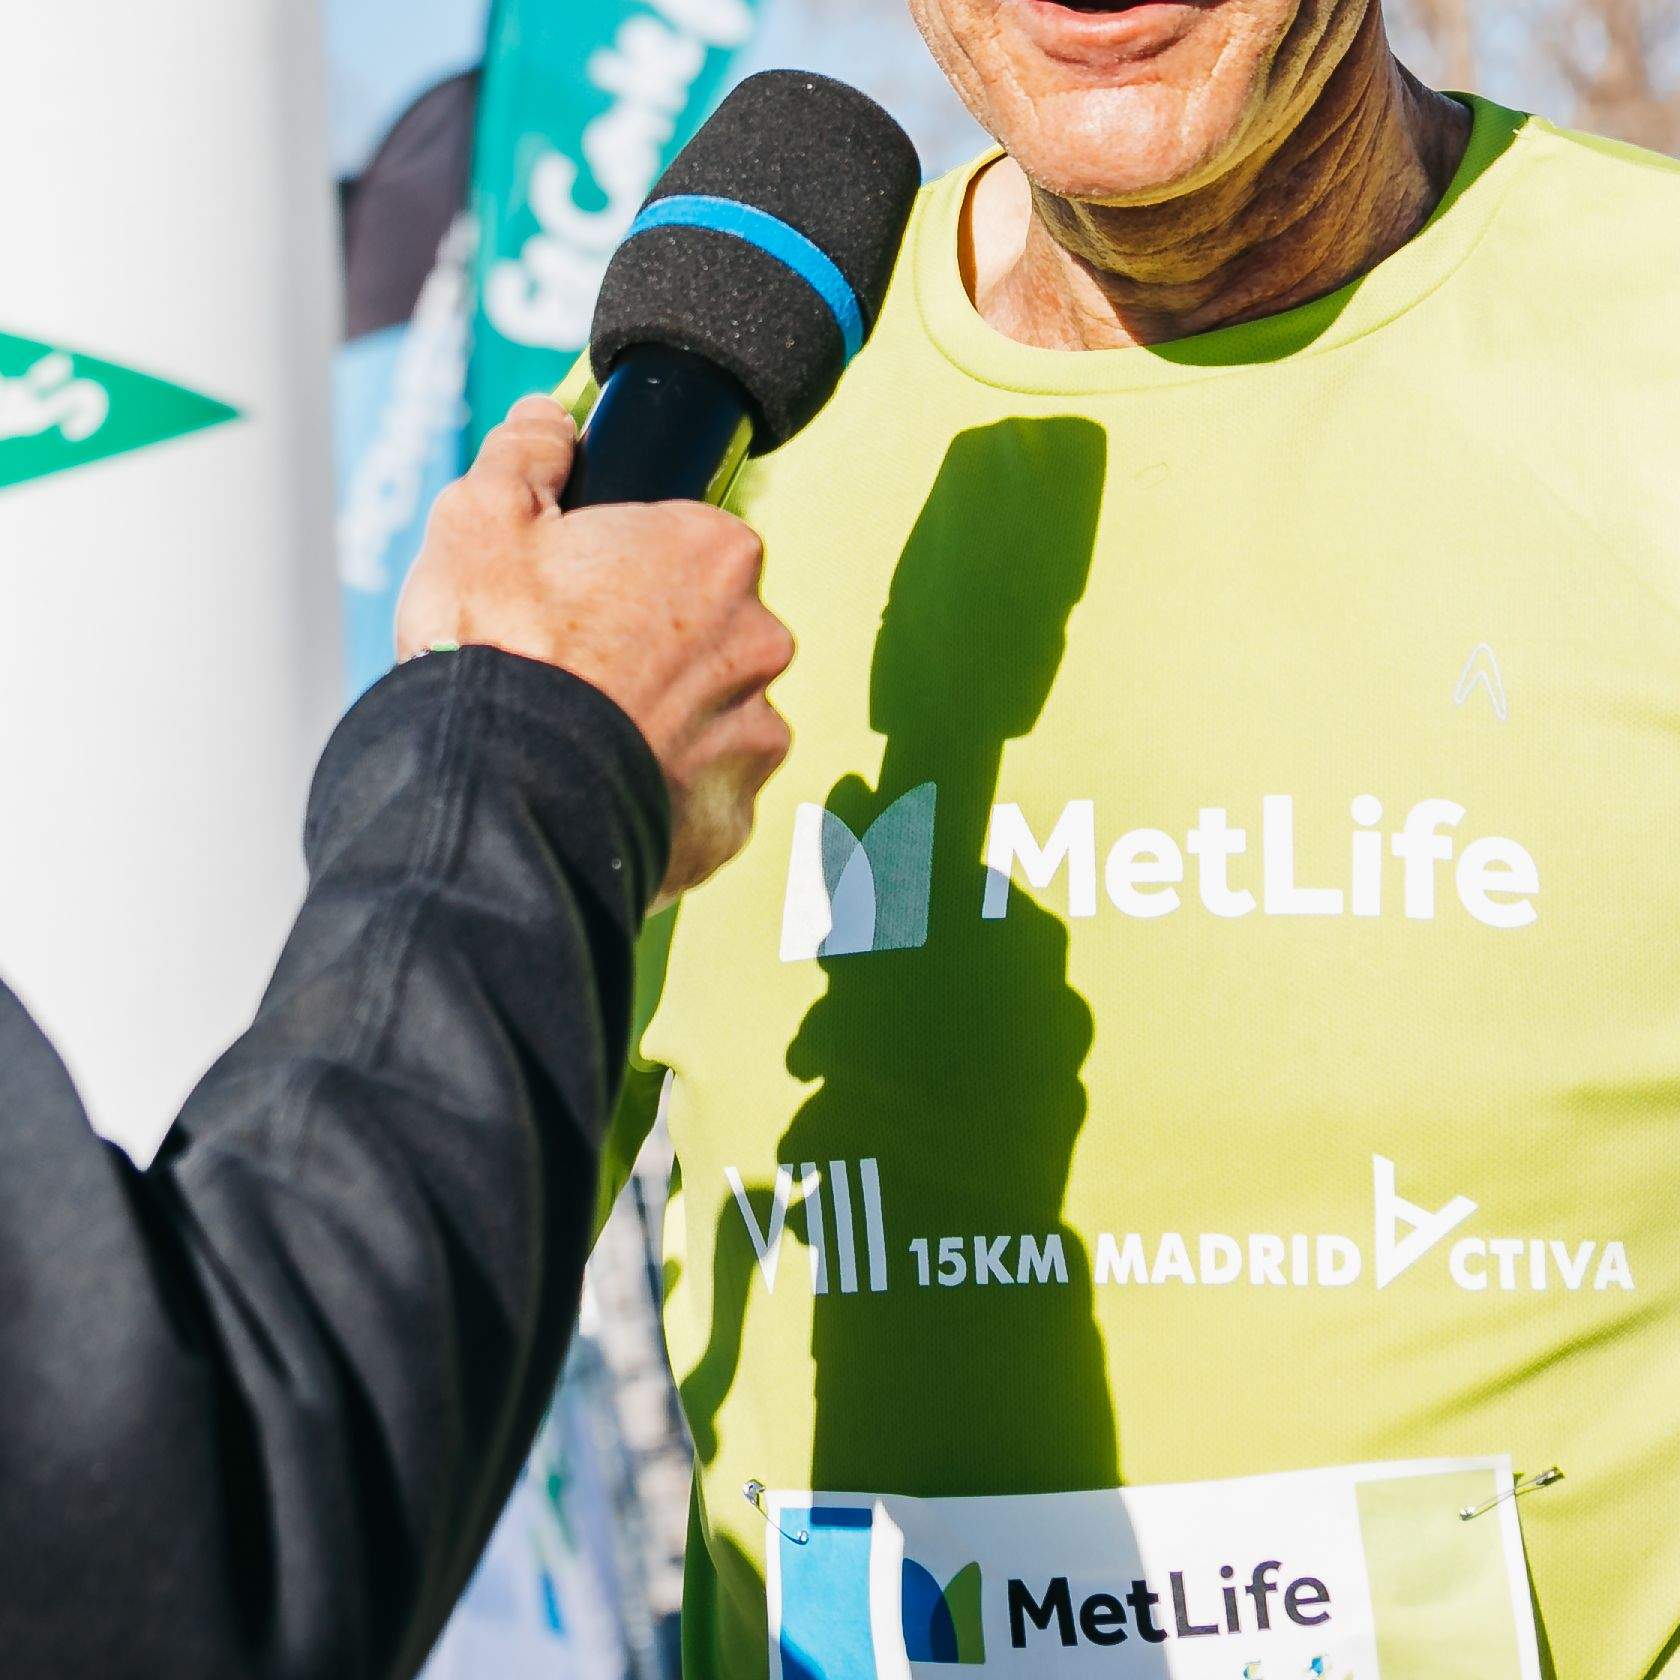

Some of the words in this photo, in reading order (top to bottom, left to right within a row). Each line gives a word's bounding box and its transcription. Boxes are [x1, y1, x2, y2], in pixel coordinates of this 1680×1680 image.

[528, 12, 708, 260] Corte
[980, 793, 1541, 930] MetLife
[908, 1234, 1070, 1288] 15KM
[1094, 1231, 1363, 1287] MADRID
[1006, 1559, 1332, 1650] MetLife
